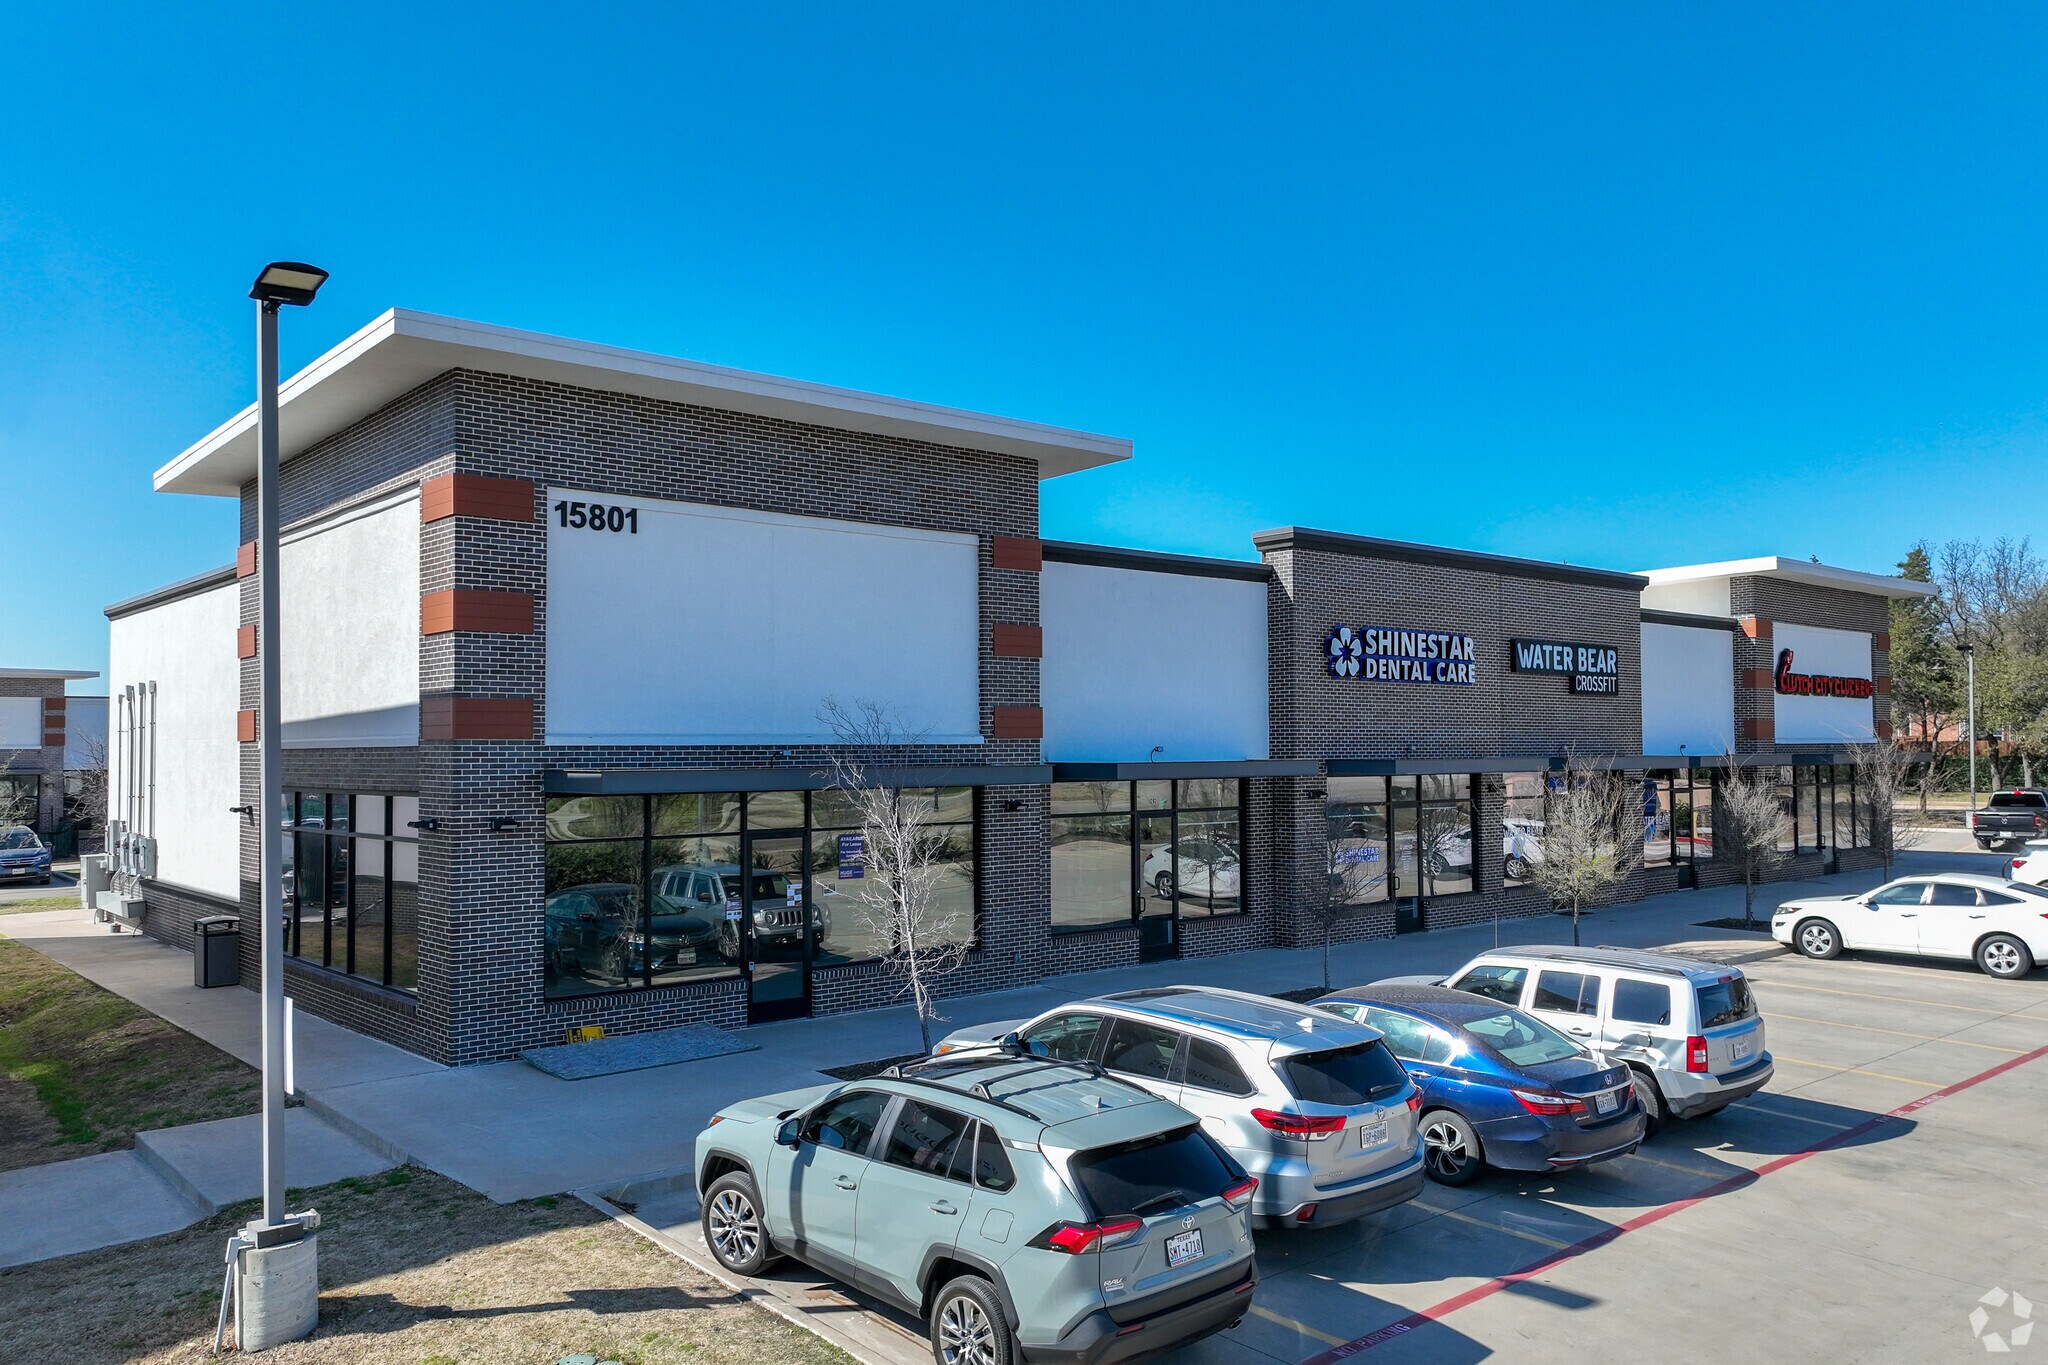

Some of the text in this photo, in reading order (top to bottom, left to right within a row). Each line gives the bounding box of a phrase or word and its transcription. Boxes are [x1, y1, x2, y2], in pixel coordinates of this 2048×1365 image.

[554, 501, 638, 534] 15801
[1366, 629, 1475, 661] SHINESTAR
[1517, 642, 1617, 674] WATER BEAR
[1366, 658, 1475, 683] DENTAL CARE
[1575, 675, 1617, 692] CROSSFIT
[1778, 662, 1813, 695] CLUTCH
[1815, 676, 1833, 694] CITY
[1177, 1234, 1191, 1243] TEXAS
[1331, 1323, 1411, 1358] NO PARKING
